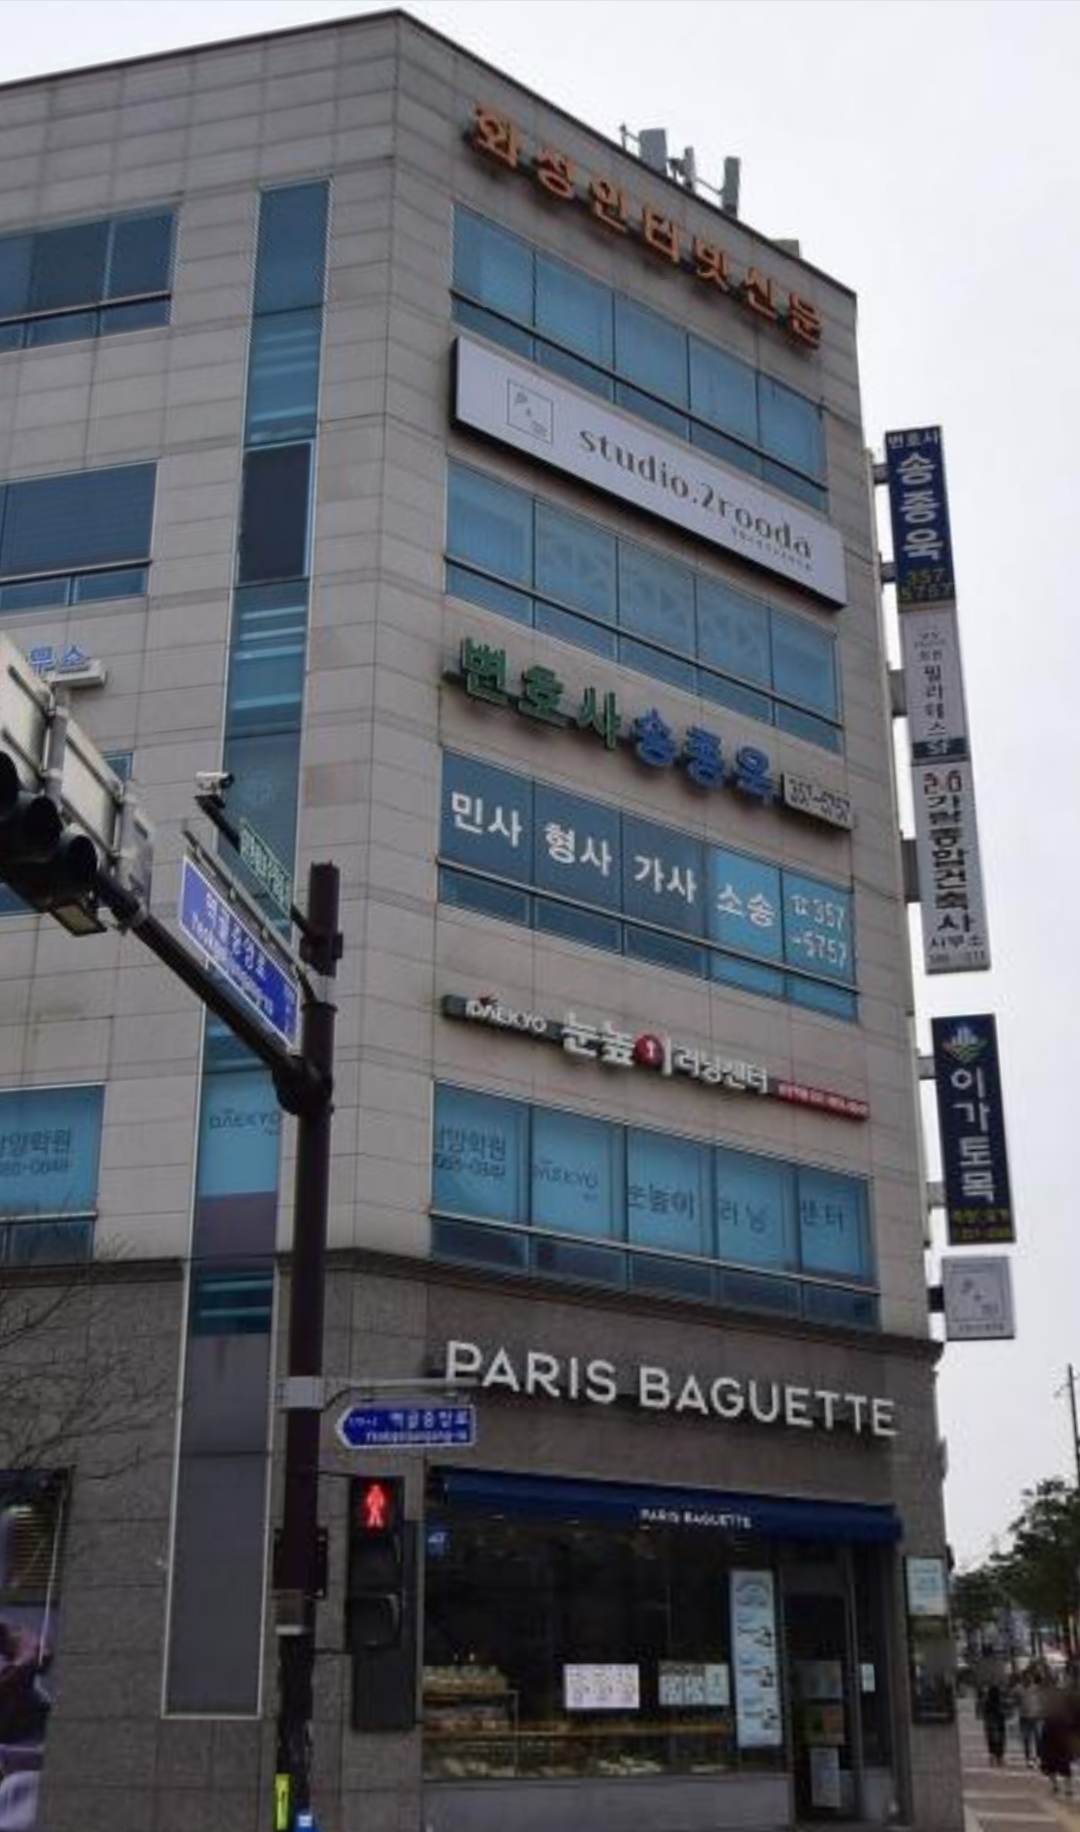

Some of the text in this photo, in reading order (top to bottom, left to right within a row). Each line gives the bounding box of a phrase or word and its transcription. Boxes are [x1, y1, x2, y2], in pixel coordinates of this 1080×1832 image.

[471, 106, 823, 349] 화성인터넷신문
[579, 427, 813, 559] studio.2rooda
[896, 452, 944, 561] 송종욱
[461, 636, 621, 750] 변호사
[631, 706, 777, 806] 송종욱
[450, 791, 775, 928] 민사 형사 가사 소송
[446, 1340, 898, 1437] PARIS BAGUETTE
[640, 1509, 752, 1529] PARIS BAGUETTE
